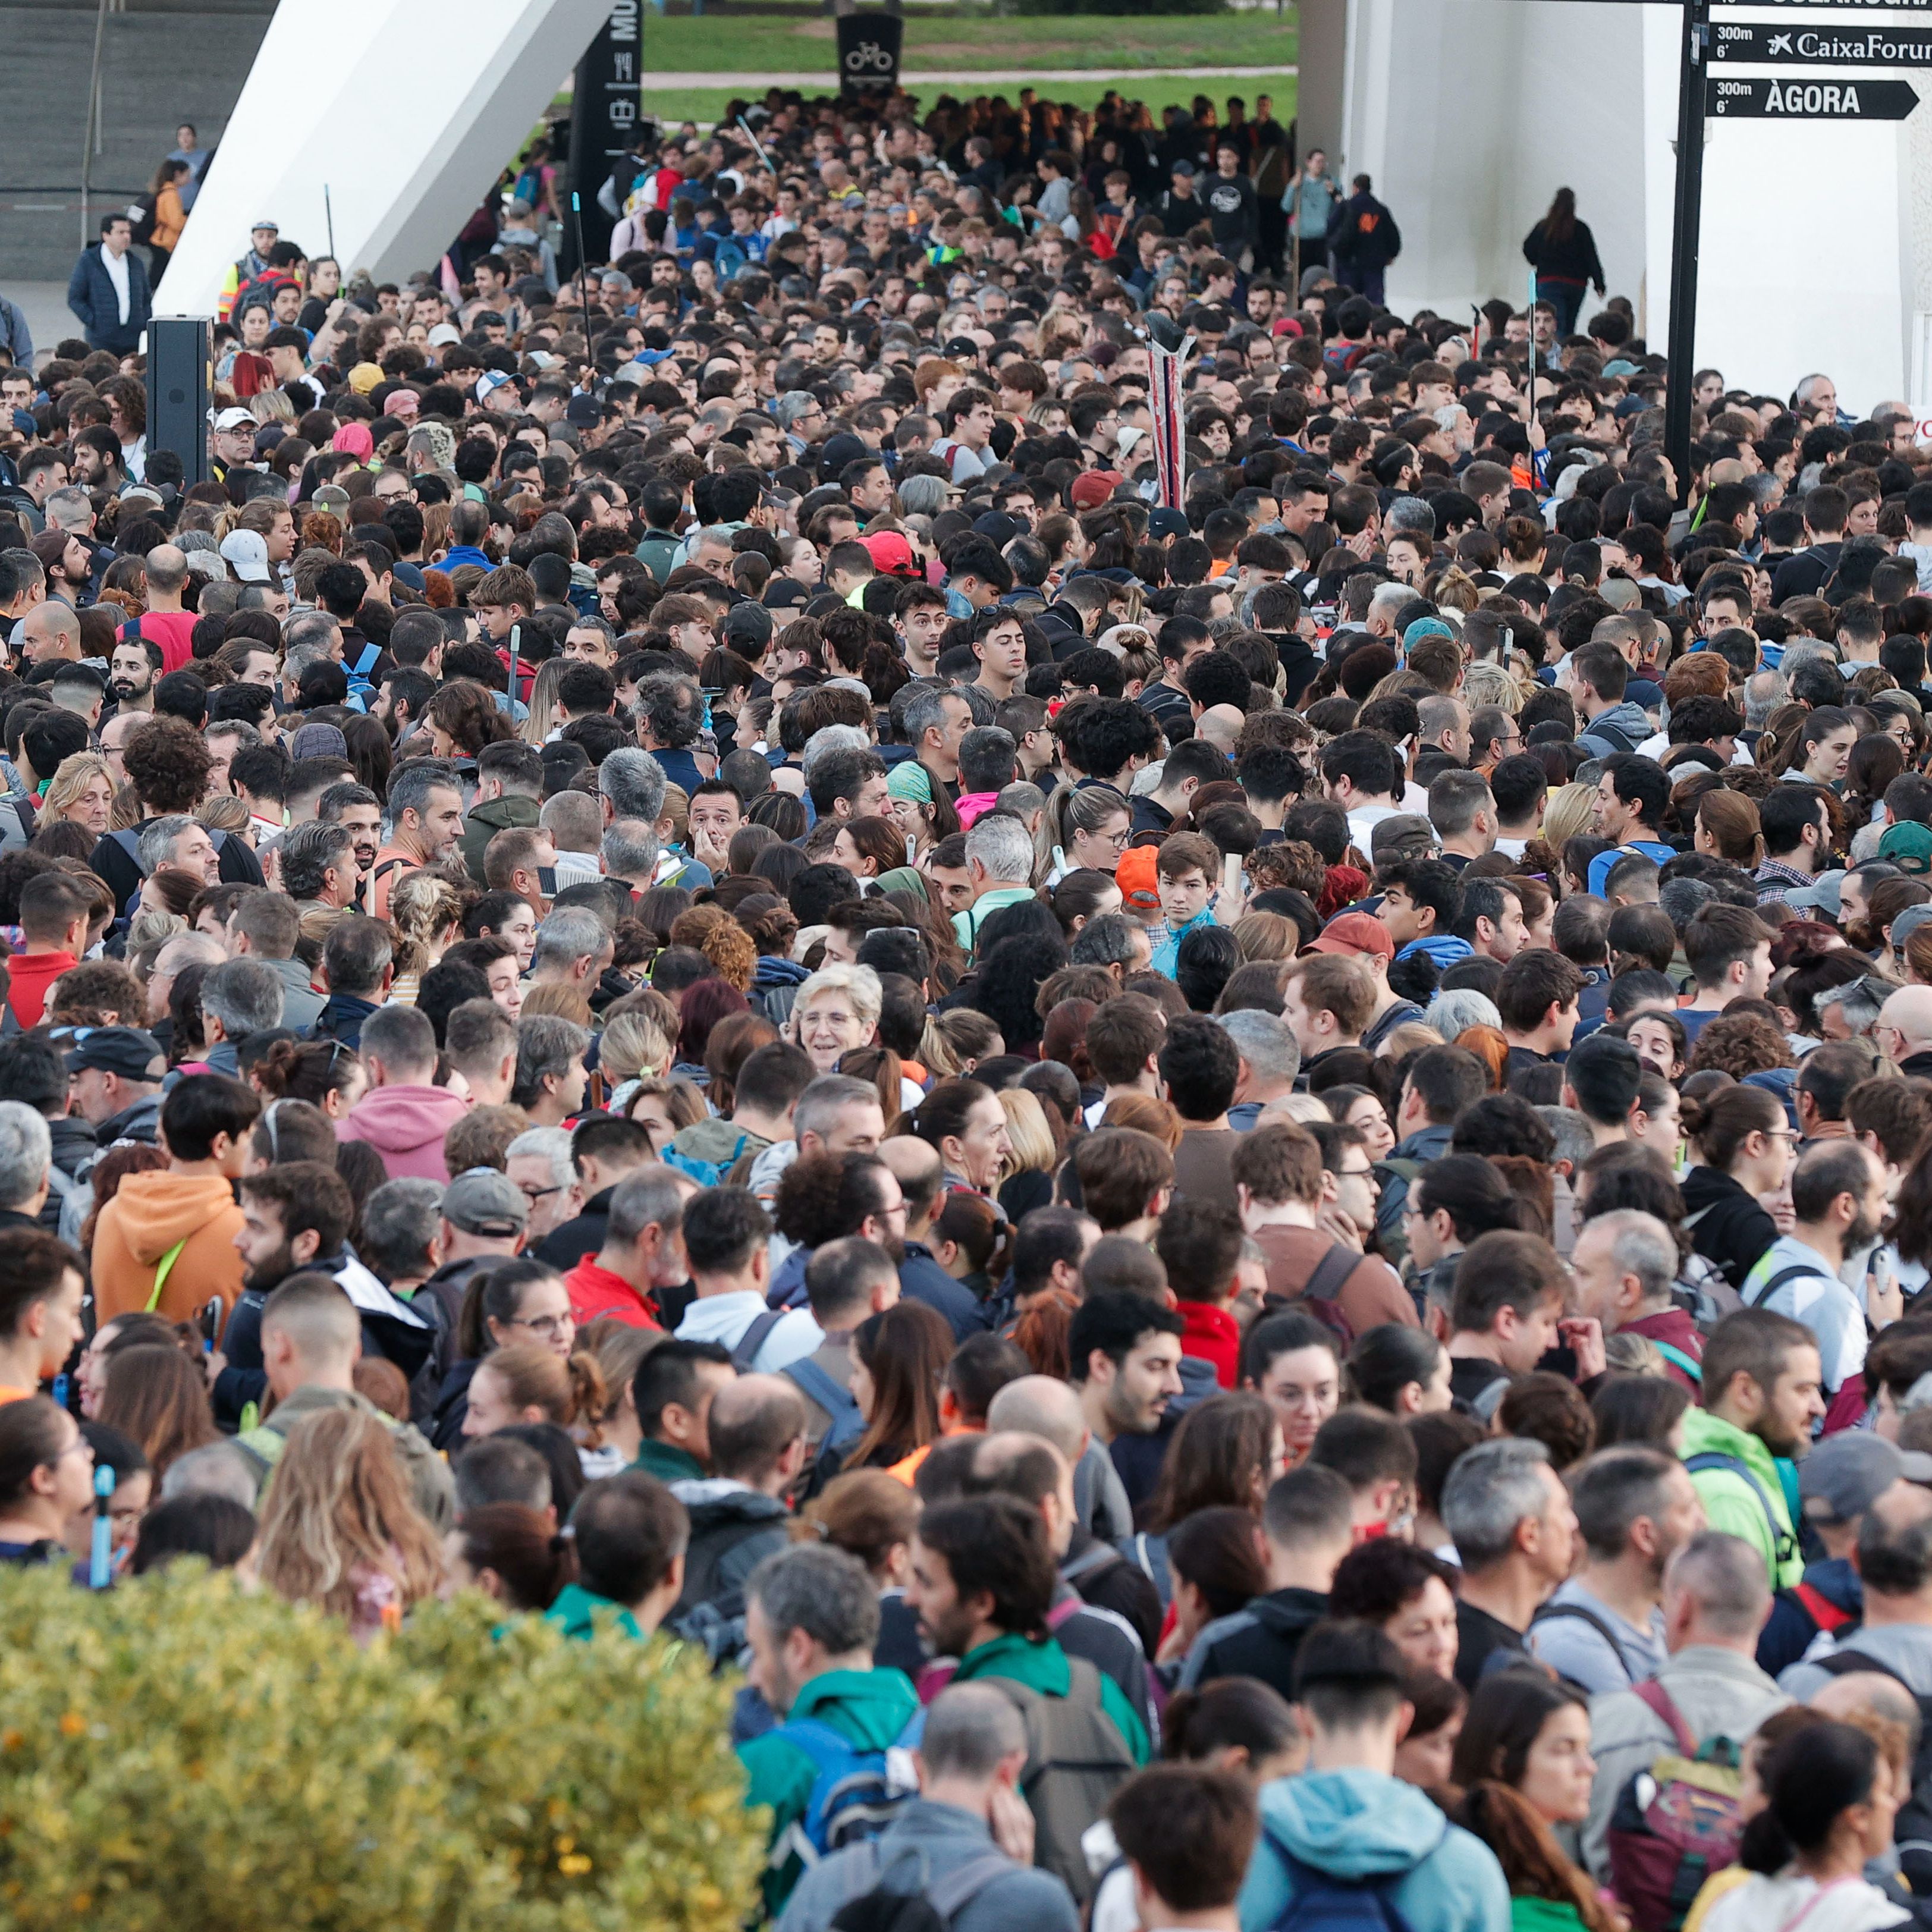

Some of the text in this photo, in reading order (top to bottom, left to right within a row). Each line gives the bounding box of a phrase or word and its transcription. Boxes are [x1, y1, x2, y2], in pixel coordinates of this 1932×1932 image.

[1717, 26, 1753, 41] 300m
[1717, 81, 1752, 96] 300m
[1765, 79, 1861, 114] ÀGORA
